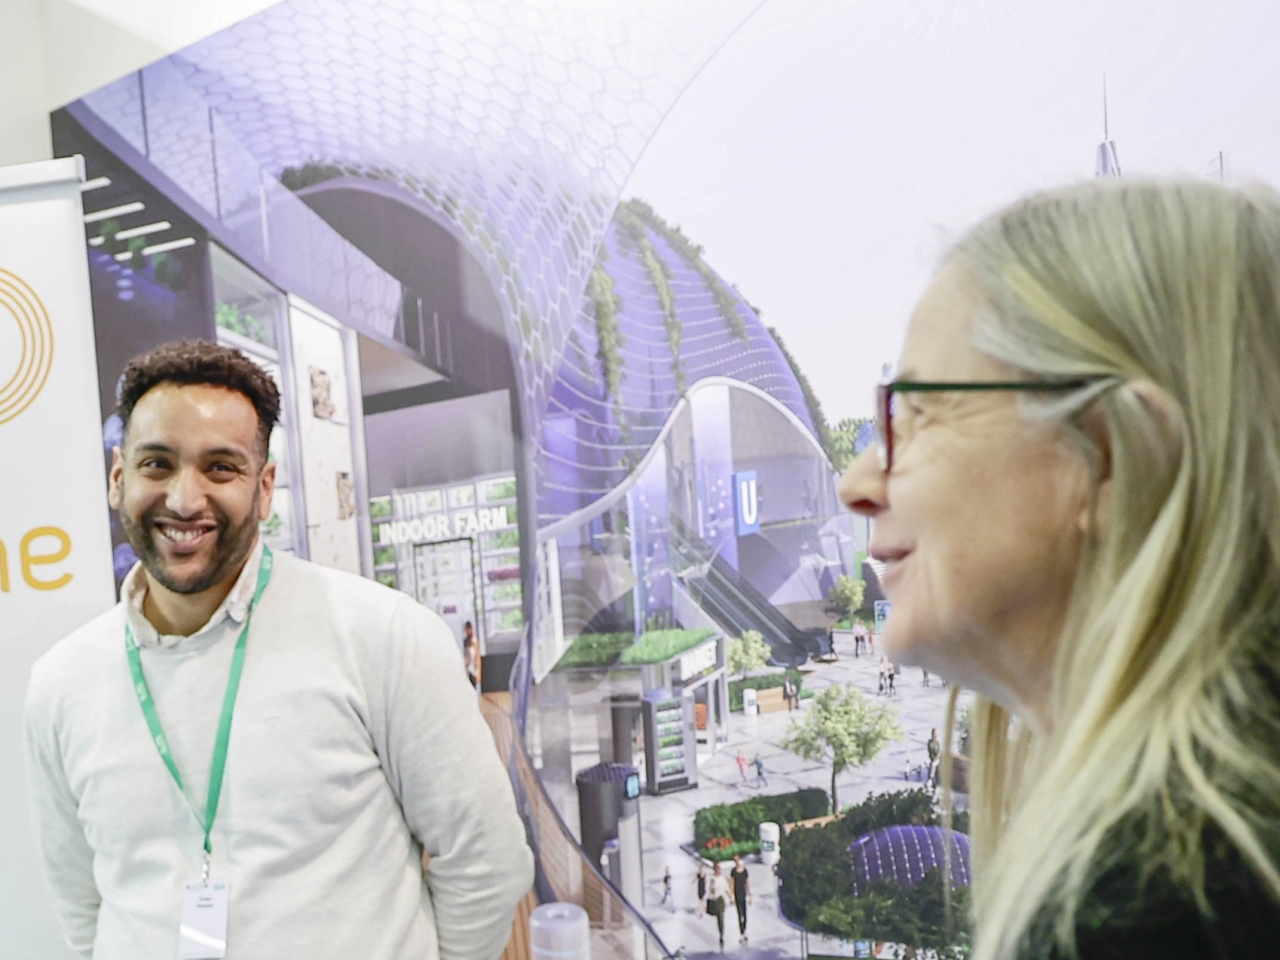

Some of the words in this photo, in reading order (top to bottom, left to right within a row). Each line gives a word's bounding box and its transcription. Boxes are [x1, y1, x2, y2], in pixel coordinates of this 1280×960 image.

[741, 480, 757, 525] U
[378, 513, 450, 544] INDOOR
[454, 505, 509, 536] FARM
